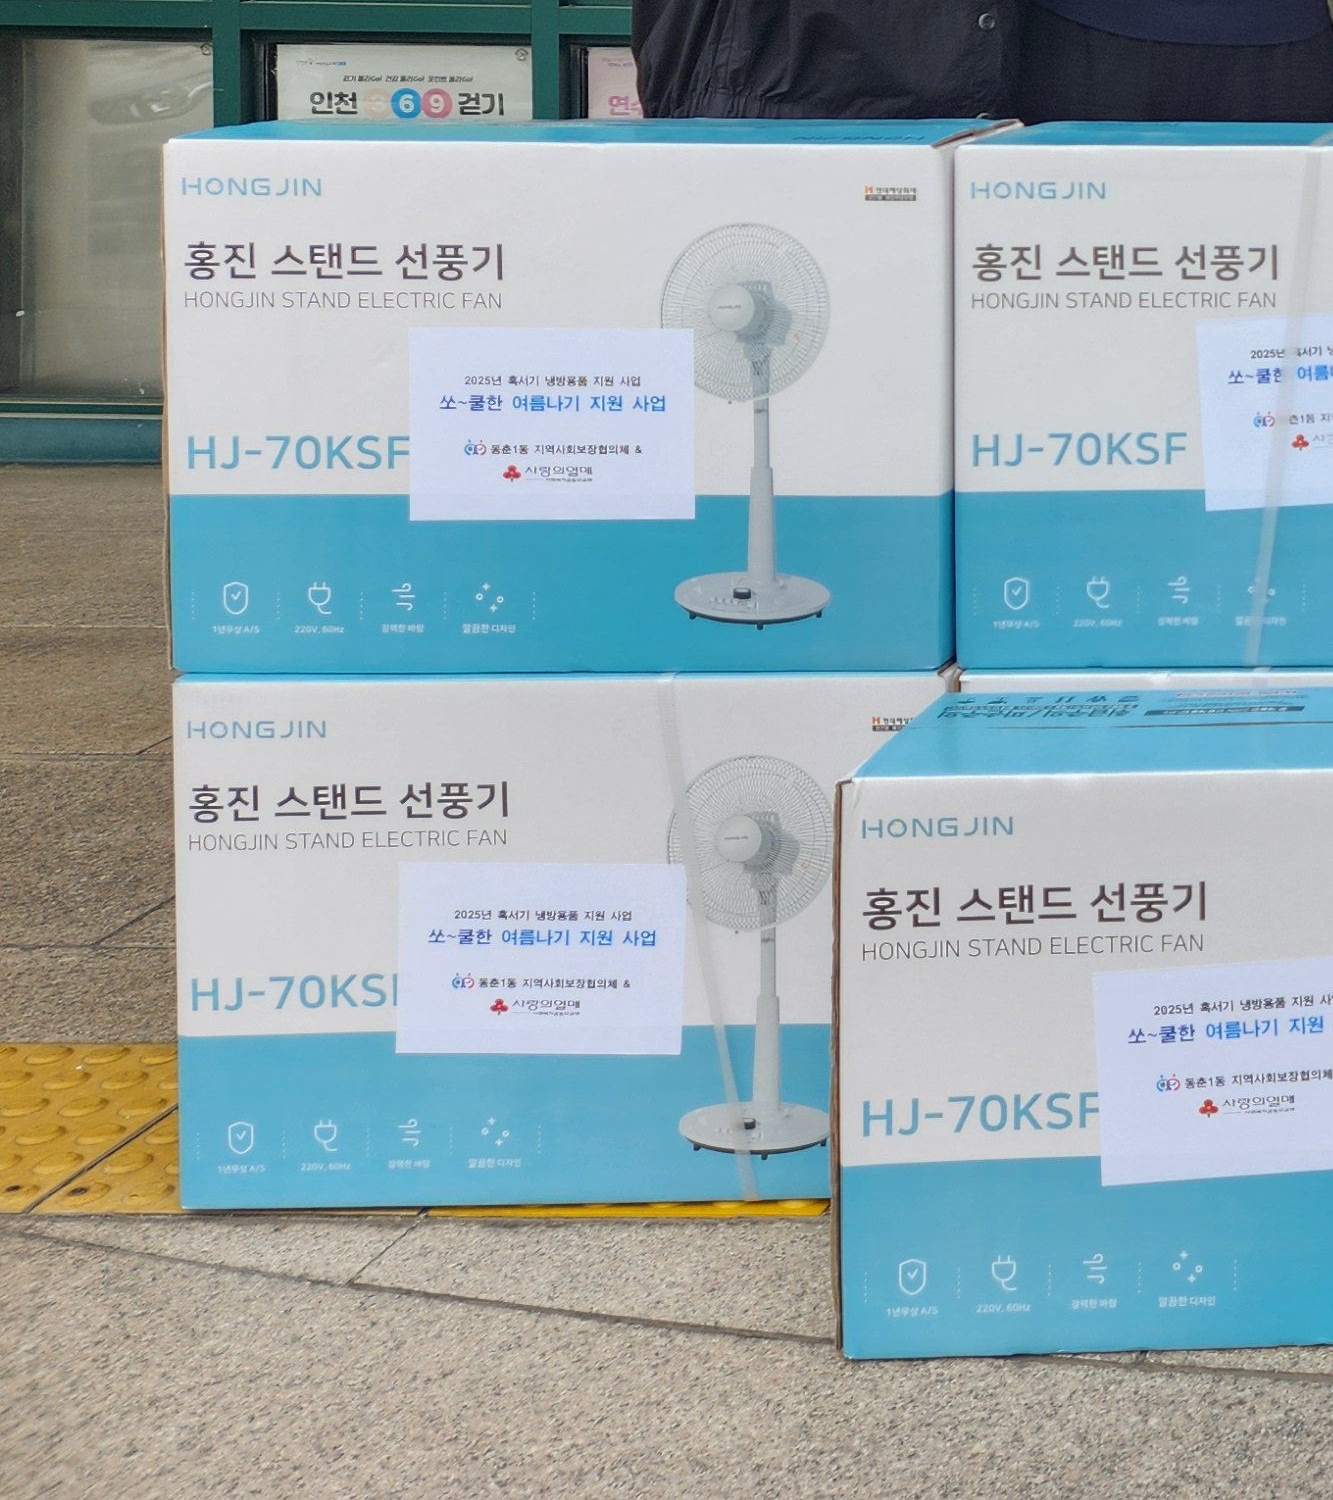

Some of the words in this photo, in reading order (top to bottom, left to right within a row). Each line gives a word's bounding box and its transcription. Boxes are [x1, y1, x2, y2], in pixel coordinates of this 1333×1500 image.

[309, 91, 359, 116] 인천
[457, 92, 505, 117] 걷기
[182, 178, 321, 196] HONGJIN
[185, 241, 256, 280] 홍진
[272, 243, 382, 279] 스탠드
[396, 244, 502, 281] 선풍기
[973, 244, 1041, 282] 홍진
[1056, 245, 1162, 280] 스탠드
[1175, 245, 1277, 281] 선풍기
[185, 291, 274, 308] HONGJIN
[282, 292, 350, 308] STAND
[359, 292, 455, 308] ELECTRIC
[463, 293, 501, 308] FAN
[465, 376, 501, 385] 2025년
[508, 376, 538, 386] 혹서기
[545, 376, 587, 386] 냉방용품
[594, 376, 613, 386] 지원
[620, 376, 640, 386] 사업
[440, 395, 503, 411] 쏘~쿨한
[513, 395, 579, 411] 여름나기
[590, 396, 622, 411] 지원
[633, 396, 665, 412] 사업
[188, 435, 409, 469] HJ-70KSF
[491, 445, 528, 454] 동춘1동
[535, 445, 629, 455] 지역사회보장협의체
[634, 444, 643, 455] &
[973, 432, 1187, 467] HJ-70KSF
[189, 785, 259, 823] 홍진
[275, 784, 386, 820] 스탠드
[399, 781, 508, 819] 선풍기
[862, 817, 1013, 839] HONGJIN
[863, 887, 940, 930] 홍진
[957, 885, 1076, 924] 스탠드
[1091, 881, 1207, 924] 선풍기
[1127, 1022, 1196, 1045] 쏘~쿨한
[1205, 1018, 1278, 1041] 여름나기
[1290, 1016, 1323, 1034] 지원
[863, 1092, 1098, 1137] HJ-70KSF
